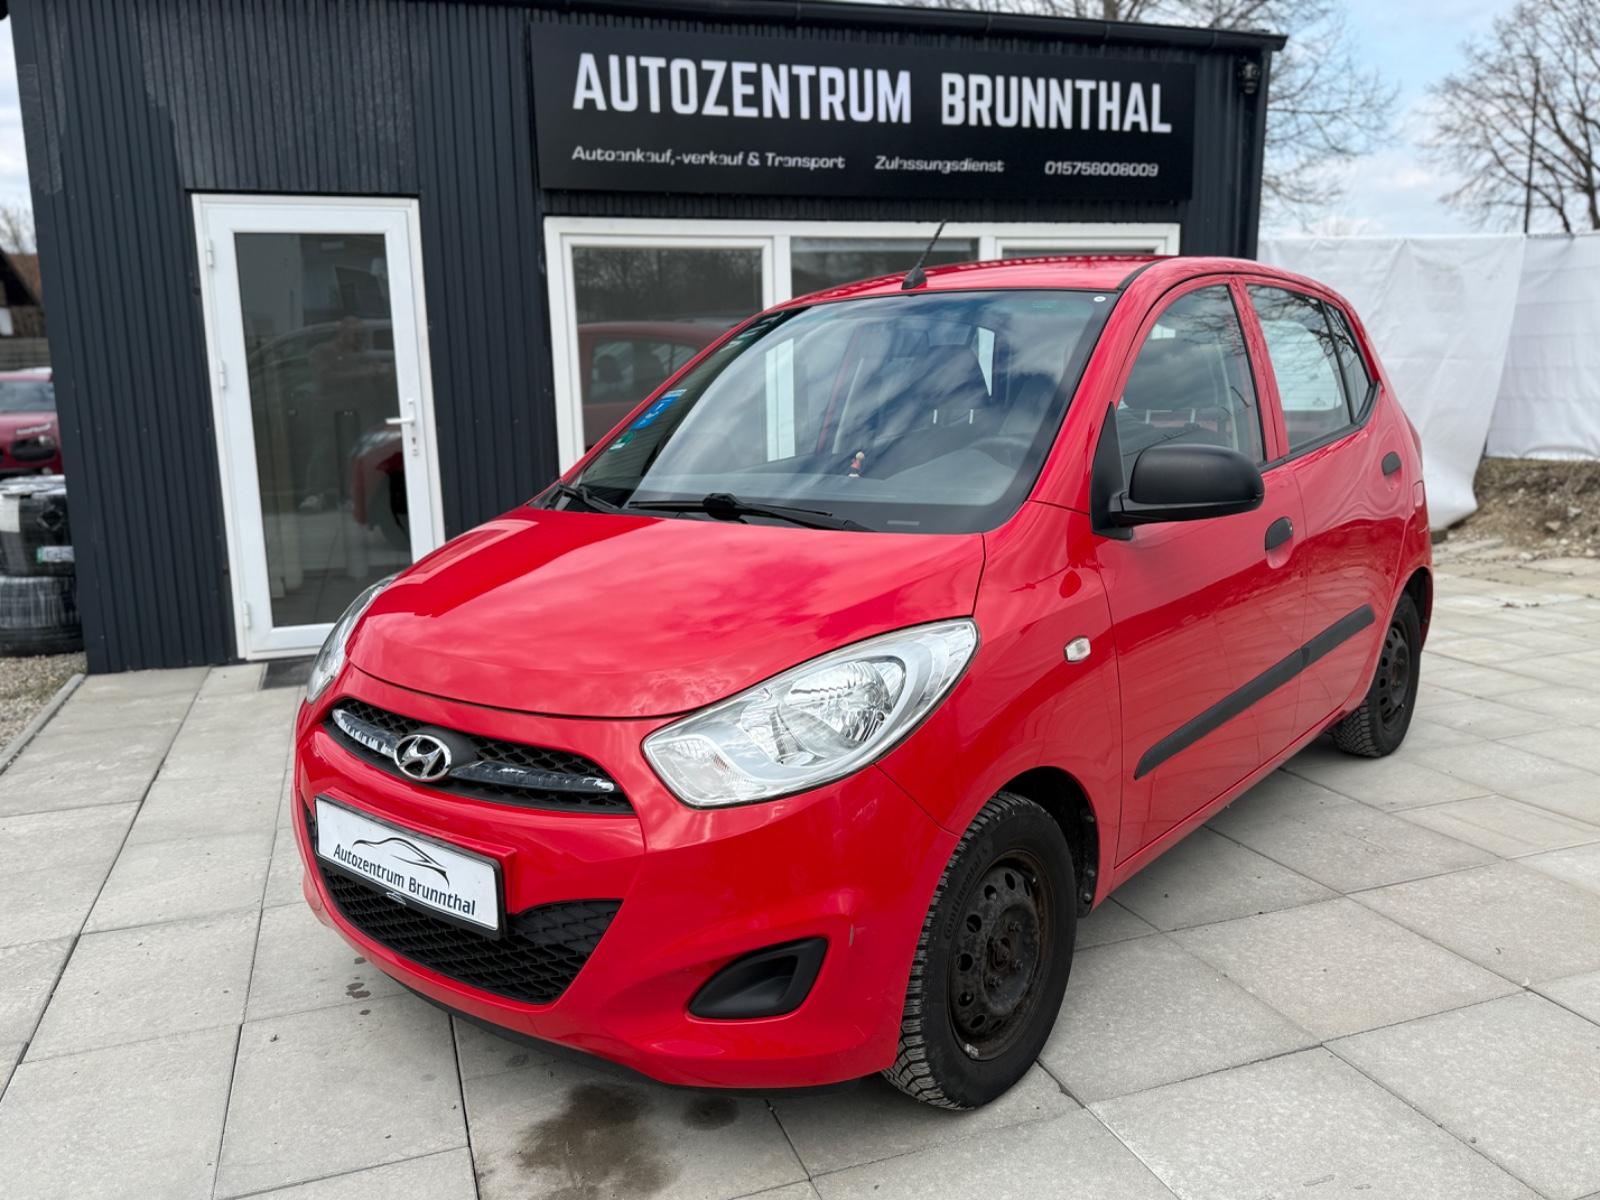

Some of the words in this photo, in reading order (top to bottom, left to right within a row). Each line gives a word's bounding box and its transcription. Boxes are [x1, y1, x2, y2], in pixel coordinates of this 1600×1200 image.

[572, 52, 912, 124] AUTOZENTRUM
[941, 72, 1172, 133] BRUNNTHAL
[746, 151, 761, 167] &
[765, 152, 845, 171] Transport
[874, 155, 1005, 174] Zulassungsdienst
[1044, 160, 1160, 177] 015758008009
[333, 843, 405, 888] Autozentrum
[408, 877, 476, 916] Brunnthal
